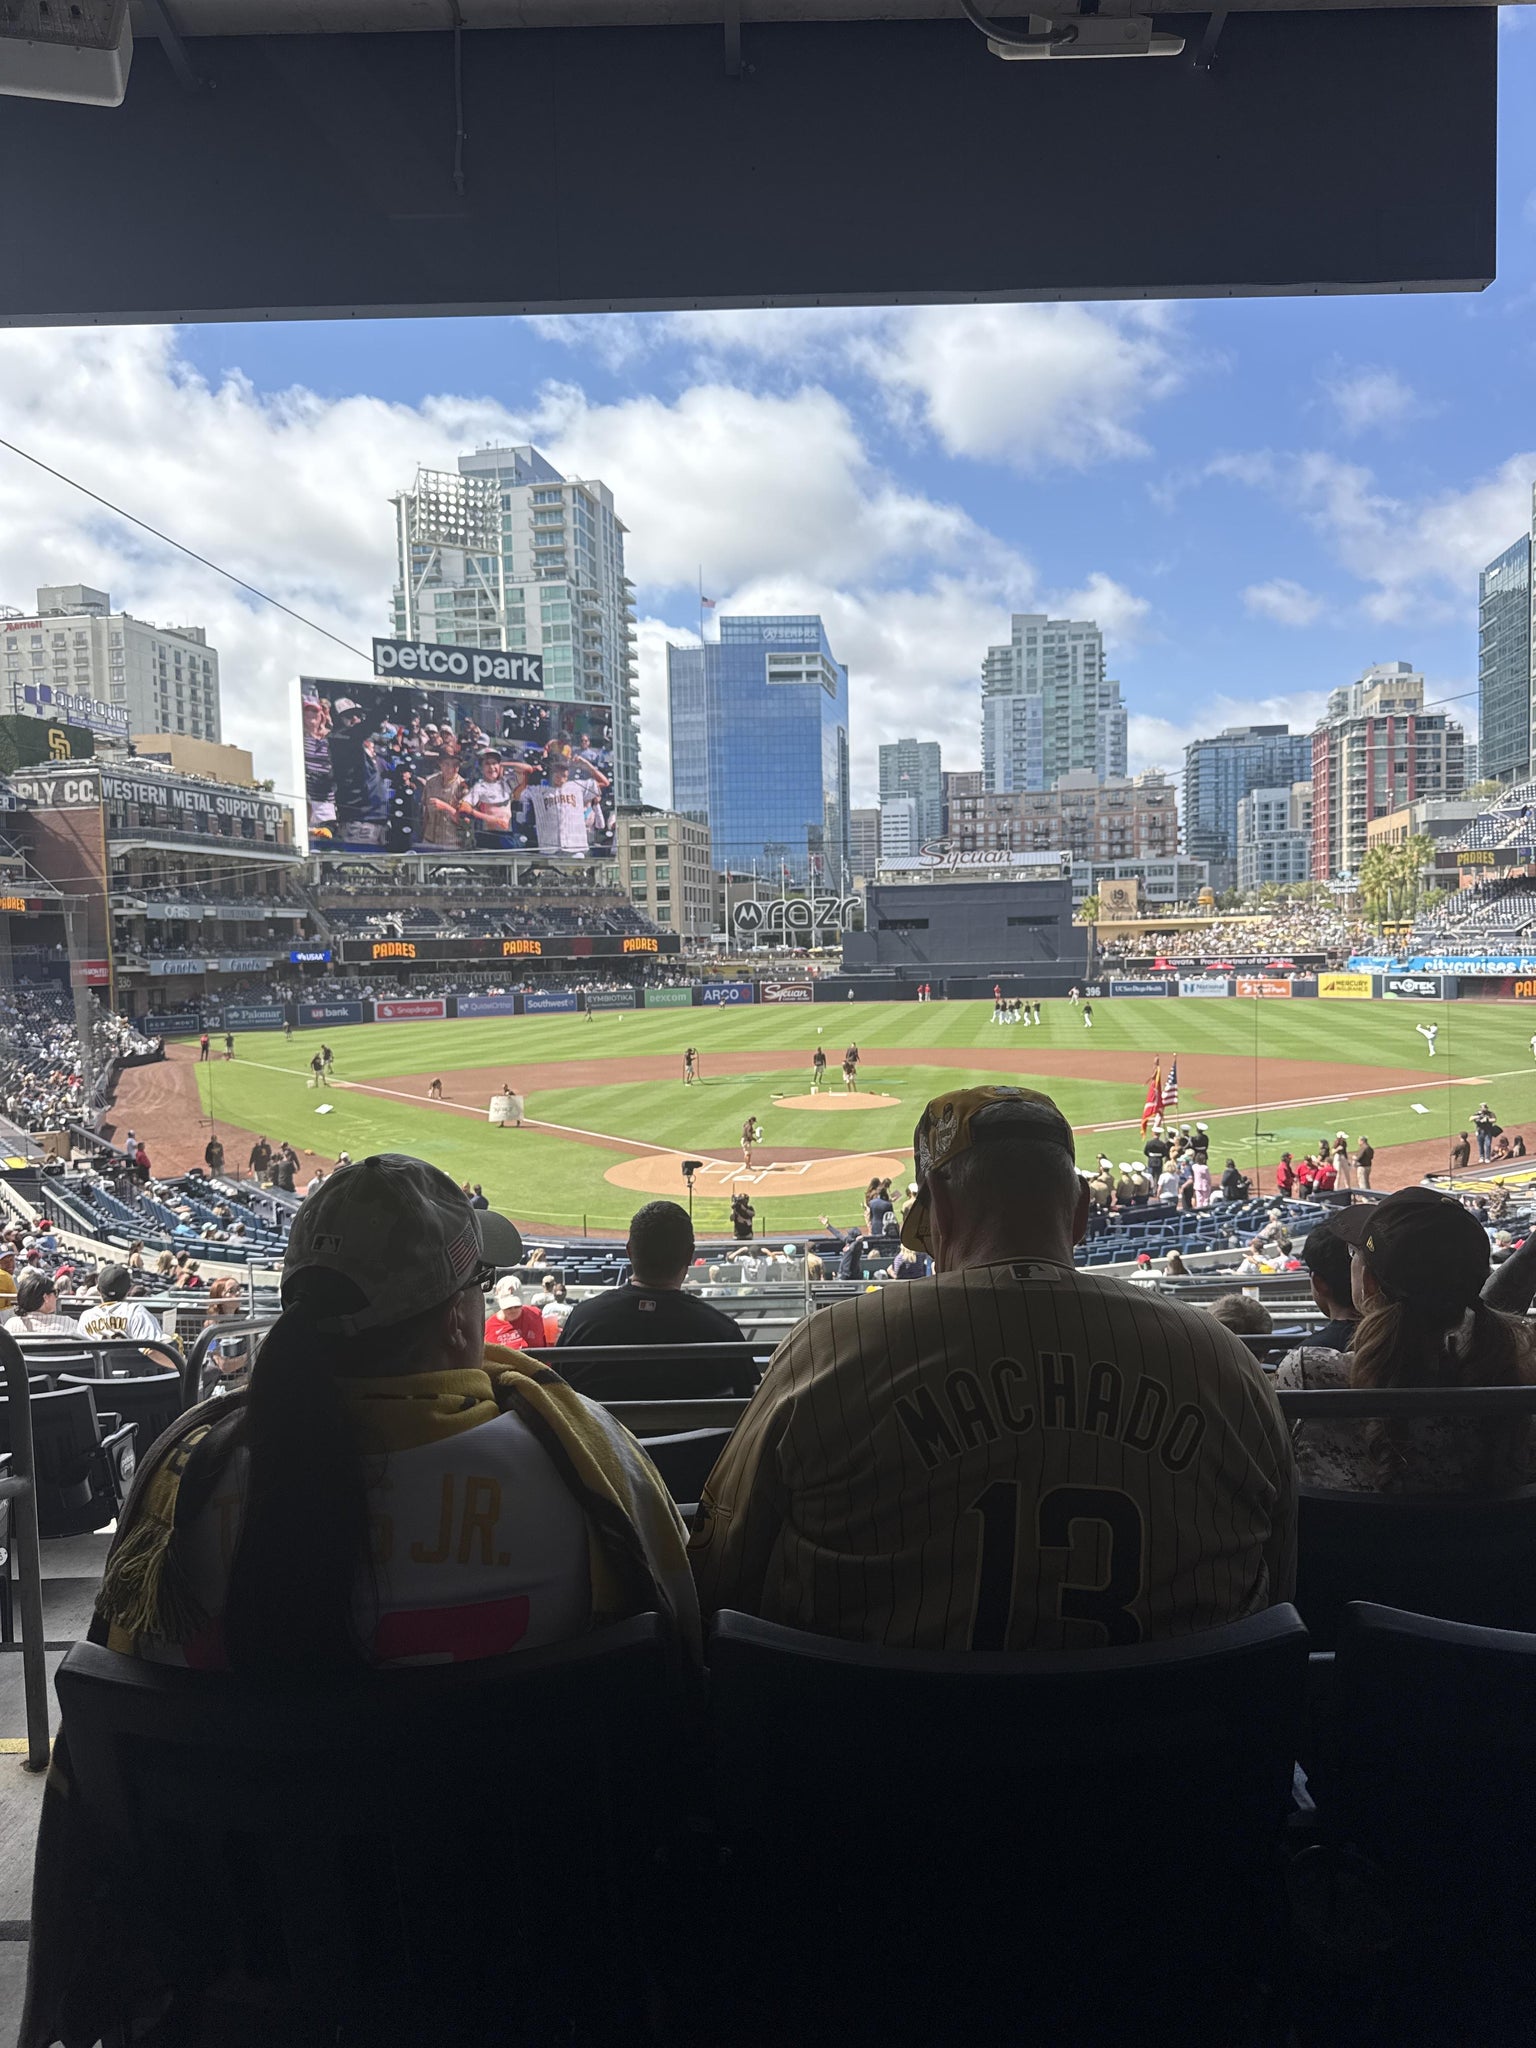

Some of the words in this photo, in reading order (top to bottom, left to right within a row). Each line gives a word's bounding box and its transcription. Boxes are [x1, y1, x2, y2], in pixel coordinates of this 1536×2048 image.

[376, 643, 469, 675] petco
[472, 654, 542, 684] park
[11, 781, 57, 805] PLY
[64, 779, 100, 803] CO.
[102, 778, 168, 806] WESTERN
[172, 790, 215, 814] METAL
[216, 796, 260, 820] SUPPLY
[263, 804, 283, 823] CO.
[919, 839, 1015, 873] Sycuan
[1456, 851, 1495, 867] PADRES
[1113, 889, 1124, 900] 19
[164, 904, 191, 918] ORIS
[766, 896, 861, 930] razr
[372, 942, 416, 960] PADRES
[503, 939, 542, 957] PADRES
[623, 937, 658, 954] PADRES
[306, 953, 324, 961] USAA
[1200, 957, 1221, 965] Proud
[118, 976, 132, 988] 336
[703, 988, 739, 1000] ARCO
[764, 984, 808, 1001] Sycuan
[1085, 986, 1101, 997] 396
[397, 1005, 438, 1015] Snapdragon
[527, 999, 569, 1009] Southwest
[242, 1009, 281, 1019] Palomar
[325, 1007, 349, 1018] bank
[202, 1016, 220, 1028] 342
[894, 1350, 1207, 1475] MACHADO
[410, 1472, 512, 1567] JR.
[964, 1479, 1145, 1652] 13
